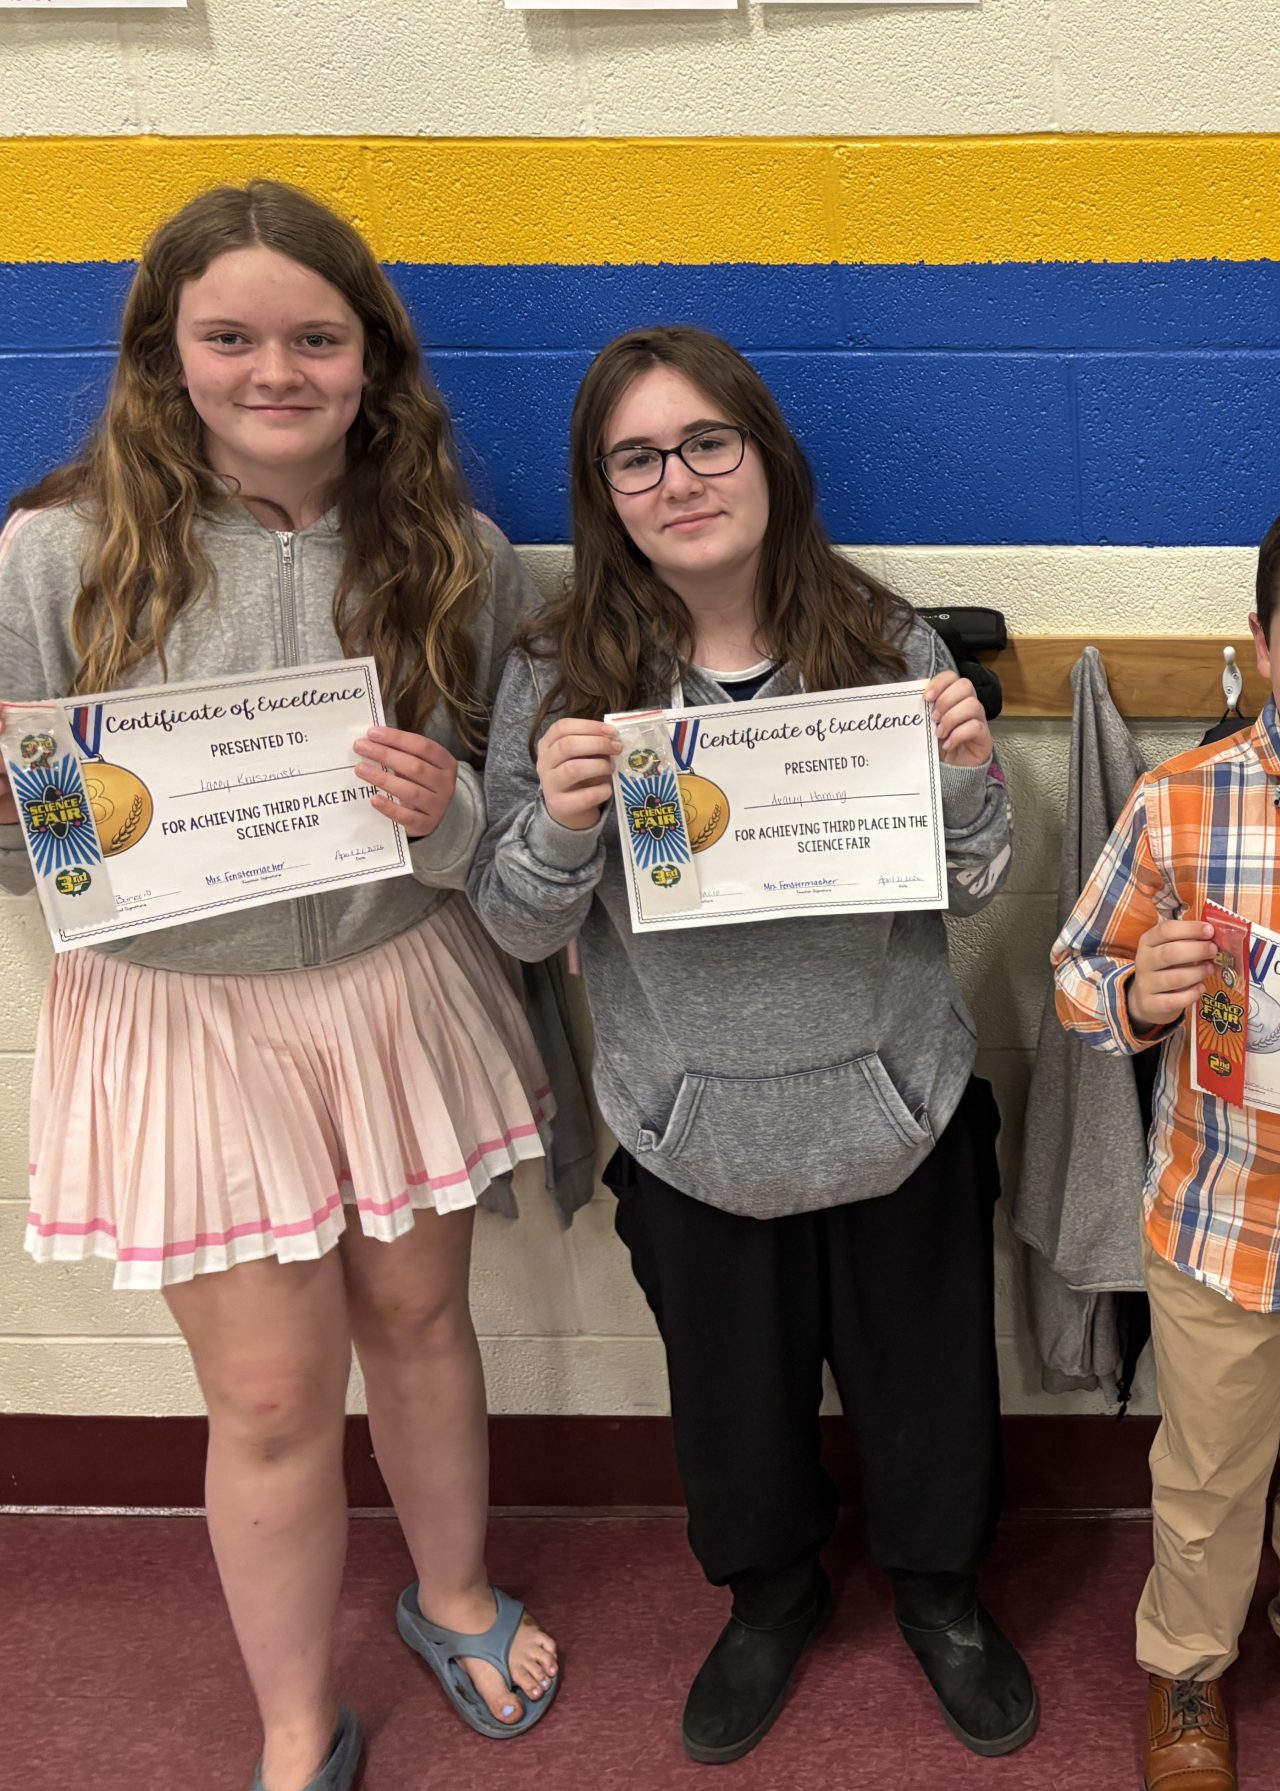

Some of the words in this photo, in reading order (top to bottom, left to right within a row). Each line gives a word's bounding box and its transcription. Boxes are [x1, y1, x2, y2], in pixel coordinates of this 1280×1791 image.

[106, 703, 227, 733] Certificate
[230, 698, 255, 721] of
[257, 687, 366, 712] Excellence
[699, 722, 803, 749] Certificate
[805, 718, 827, 741] of
[829, 713, 924, 734] Excellence
[210, 733, 284, 758] PRESENTED
[286, 731, 309, 746] TO:
[784, 757, 848, 775] PRESENTED
[850, 755, 870, 768] TO:
[29, 799, 80, 816] SCIENCE
[161, 819, 187, 836] FOR
[190, 805, 261, 831] ACHIEVING
[262, 798, 301, 817] THIRD
[302, 792, 340, 809] PLACE
[341, 787, 357, 803] IN
[632, 805, 675, 819] SCIENCE
[31, 808, 82, 827] FAIR
[634, 814, 676, 829] FAIR
[236, 819, 290, 841] SCIENCE
[291, 814, 320, 831] FAIR
[734, 829, 756, 842] FOR
[758, 822, 821, 840] ACHIEVING
[822, 819, 856, 834] THIRD
[858, 817, 891, 831] PLACE
[892, 816, 907, 829] IN
[908, 815, 928, 828] THE
[797, 838, 844, 853] SCIENCE
[845, 836, 871, 850] FAIR
[652, 868, 679, 885] 3rd
[1203, 998, 1240, 1015] SCIENCE
[1203, 1004, 1240, 1025] FAIR
[1209, 1055, 1231, 1071] 2nd
